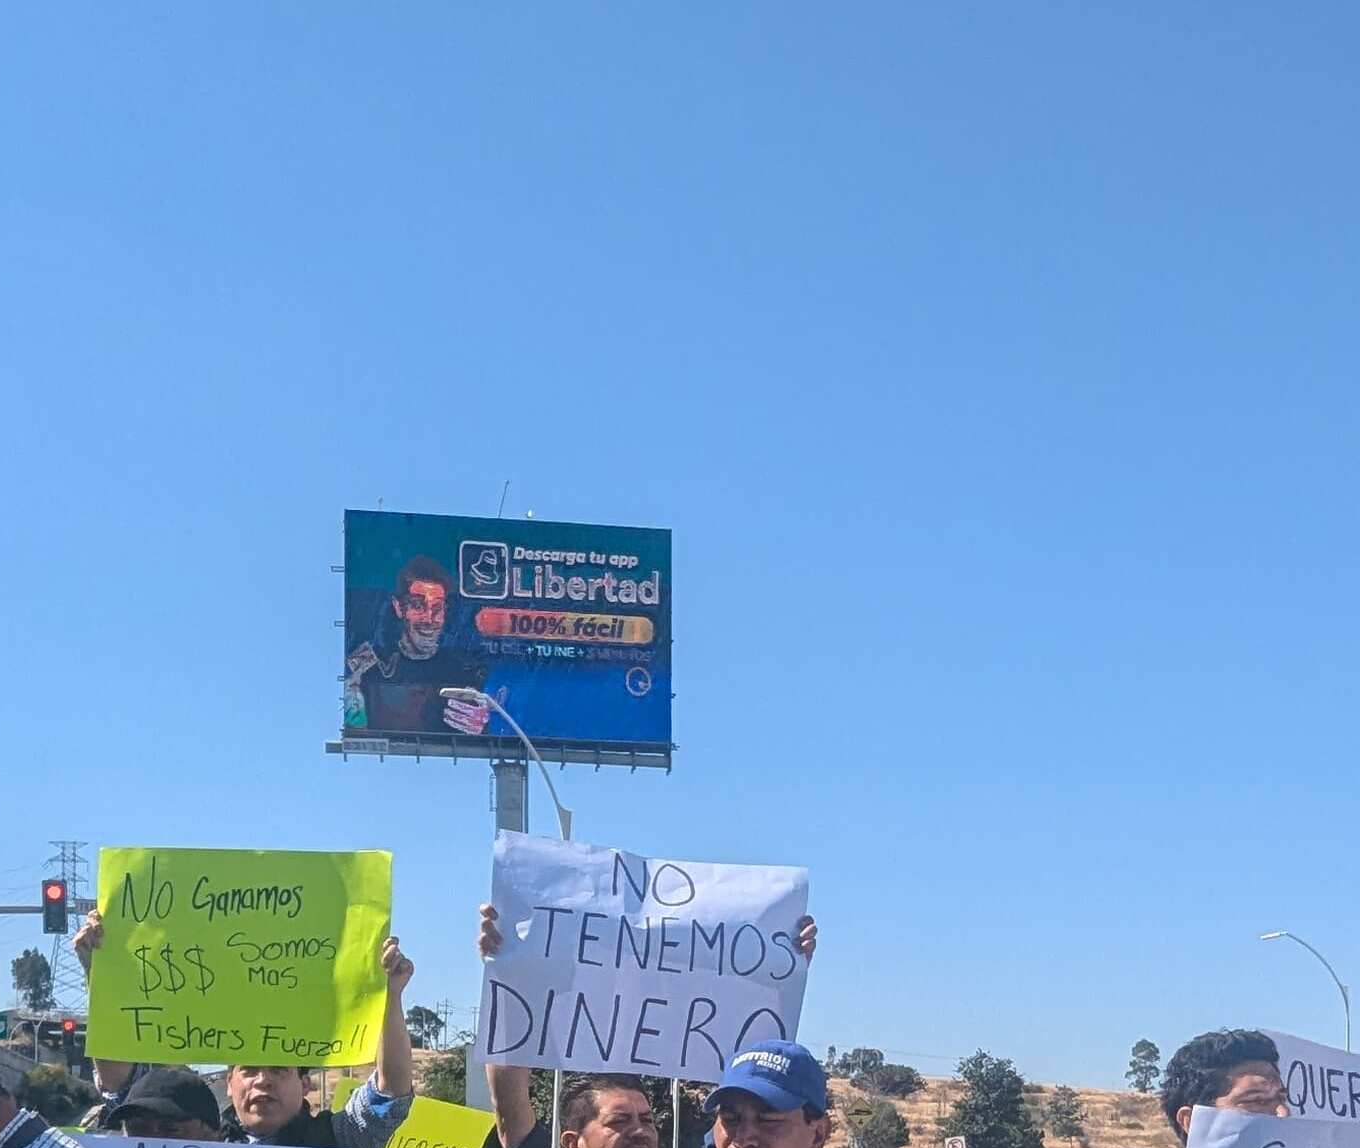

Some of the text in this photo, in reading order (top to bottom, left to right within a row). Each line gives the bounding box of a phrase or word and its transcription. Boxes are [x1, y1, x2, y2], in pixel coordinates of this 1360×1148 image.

[513, 547, 639, 569] Descarga tu app
[512, 564, 660, 605] Libertad
[509, 614, 625, 639] 100% fácil
[536, 645, 551, 657] TU
[553, 646, 575, 658] INE
[193, 876, 304, 922] Ganamos
[612, 853, 695, 906] NO
[134, 932, 337, 1000] $$$ Somos
[533, 906, 796, 980] TENEMOS
[487, 980, 787, 1071] DINERO
